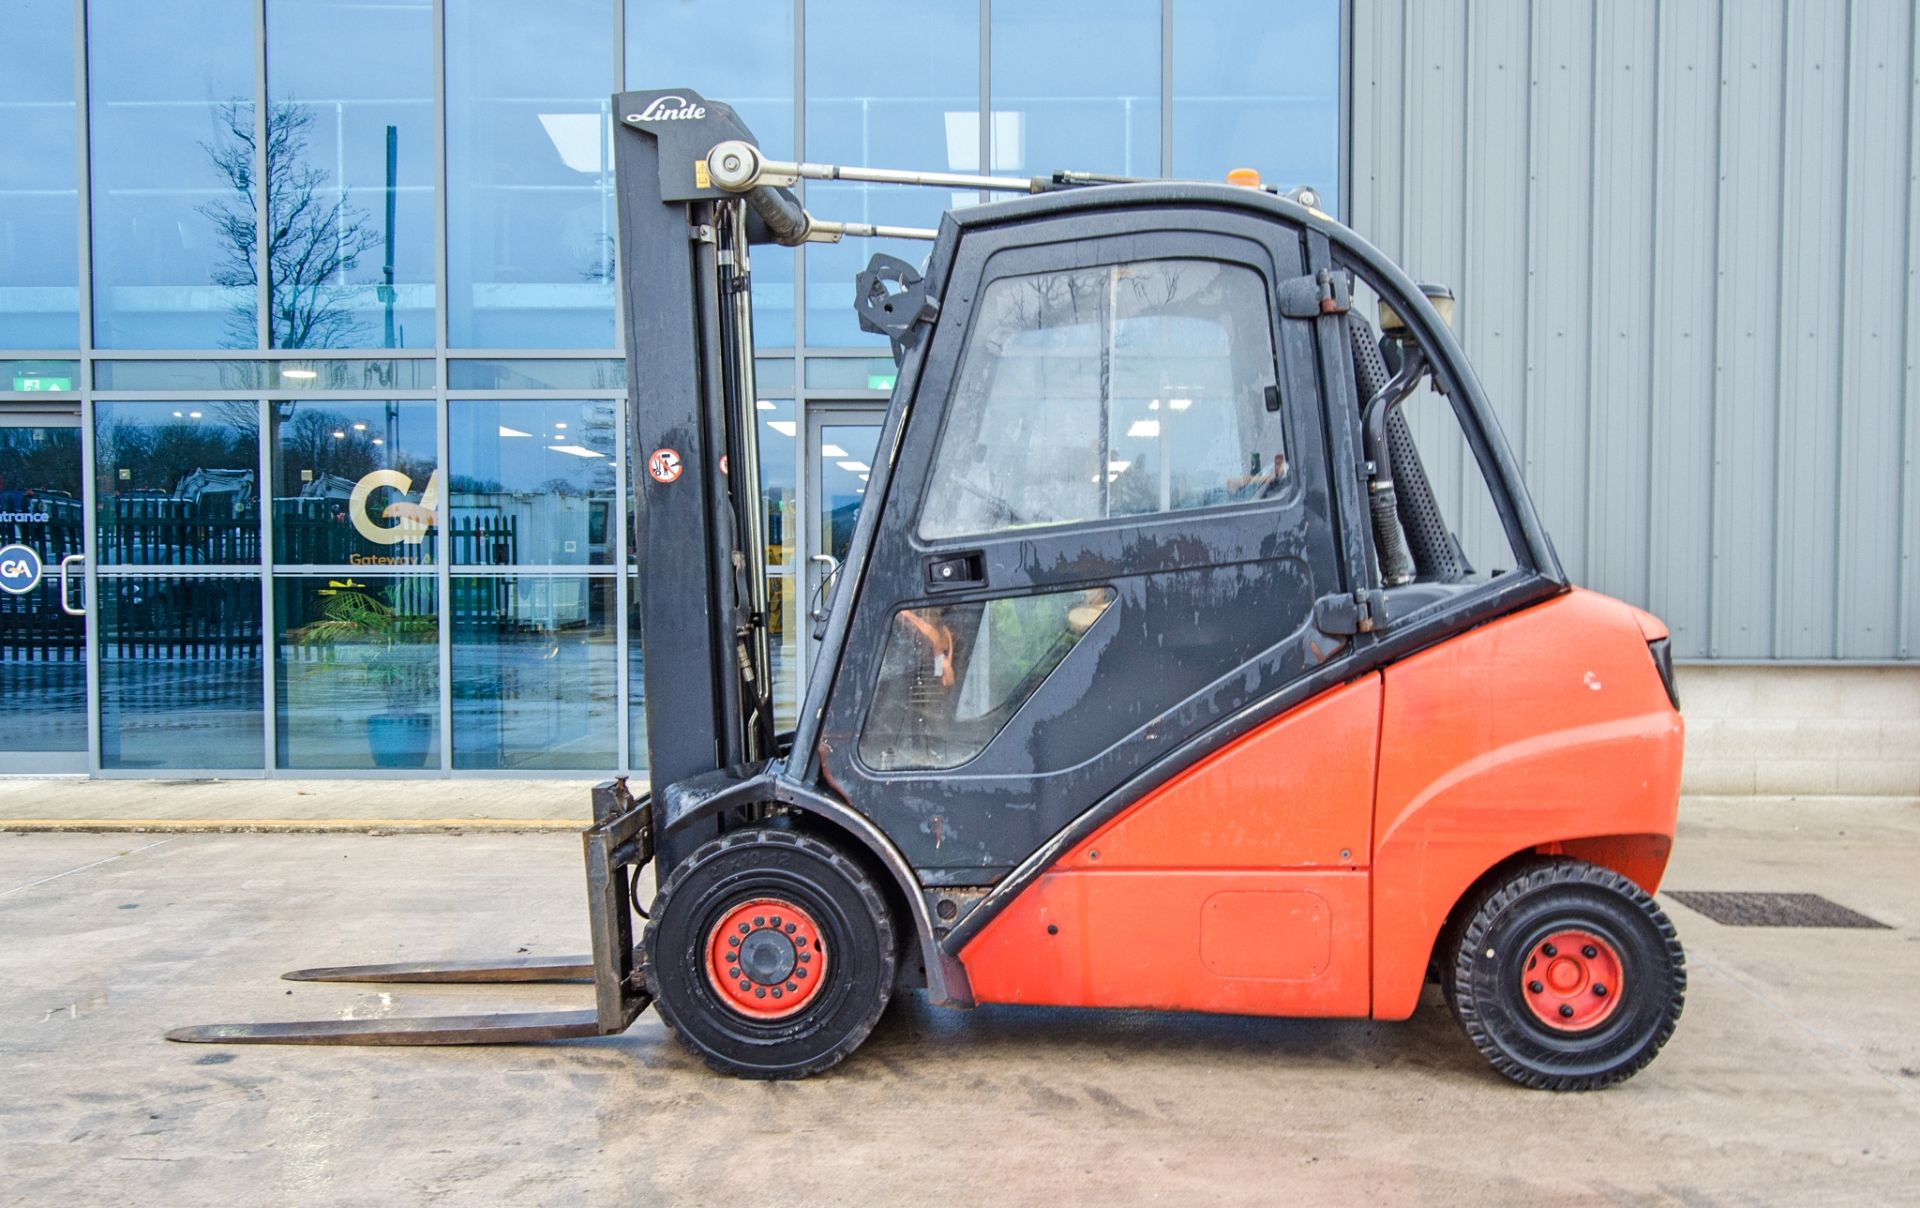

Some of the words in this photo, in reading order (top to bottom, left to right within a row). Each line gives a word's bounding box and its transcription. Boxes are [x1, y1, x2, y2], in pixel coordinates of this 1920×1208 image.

[627, 96, 706, 122] Linde
[0, 511, 49, 523] trance
[350, 553, 418, 566] Gateway
[1, 560, 33, 578] GA
